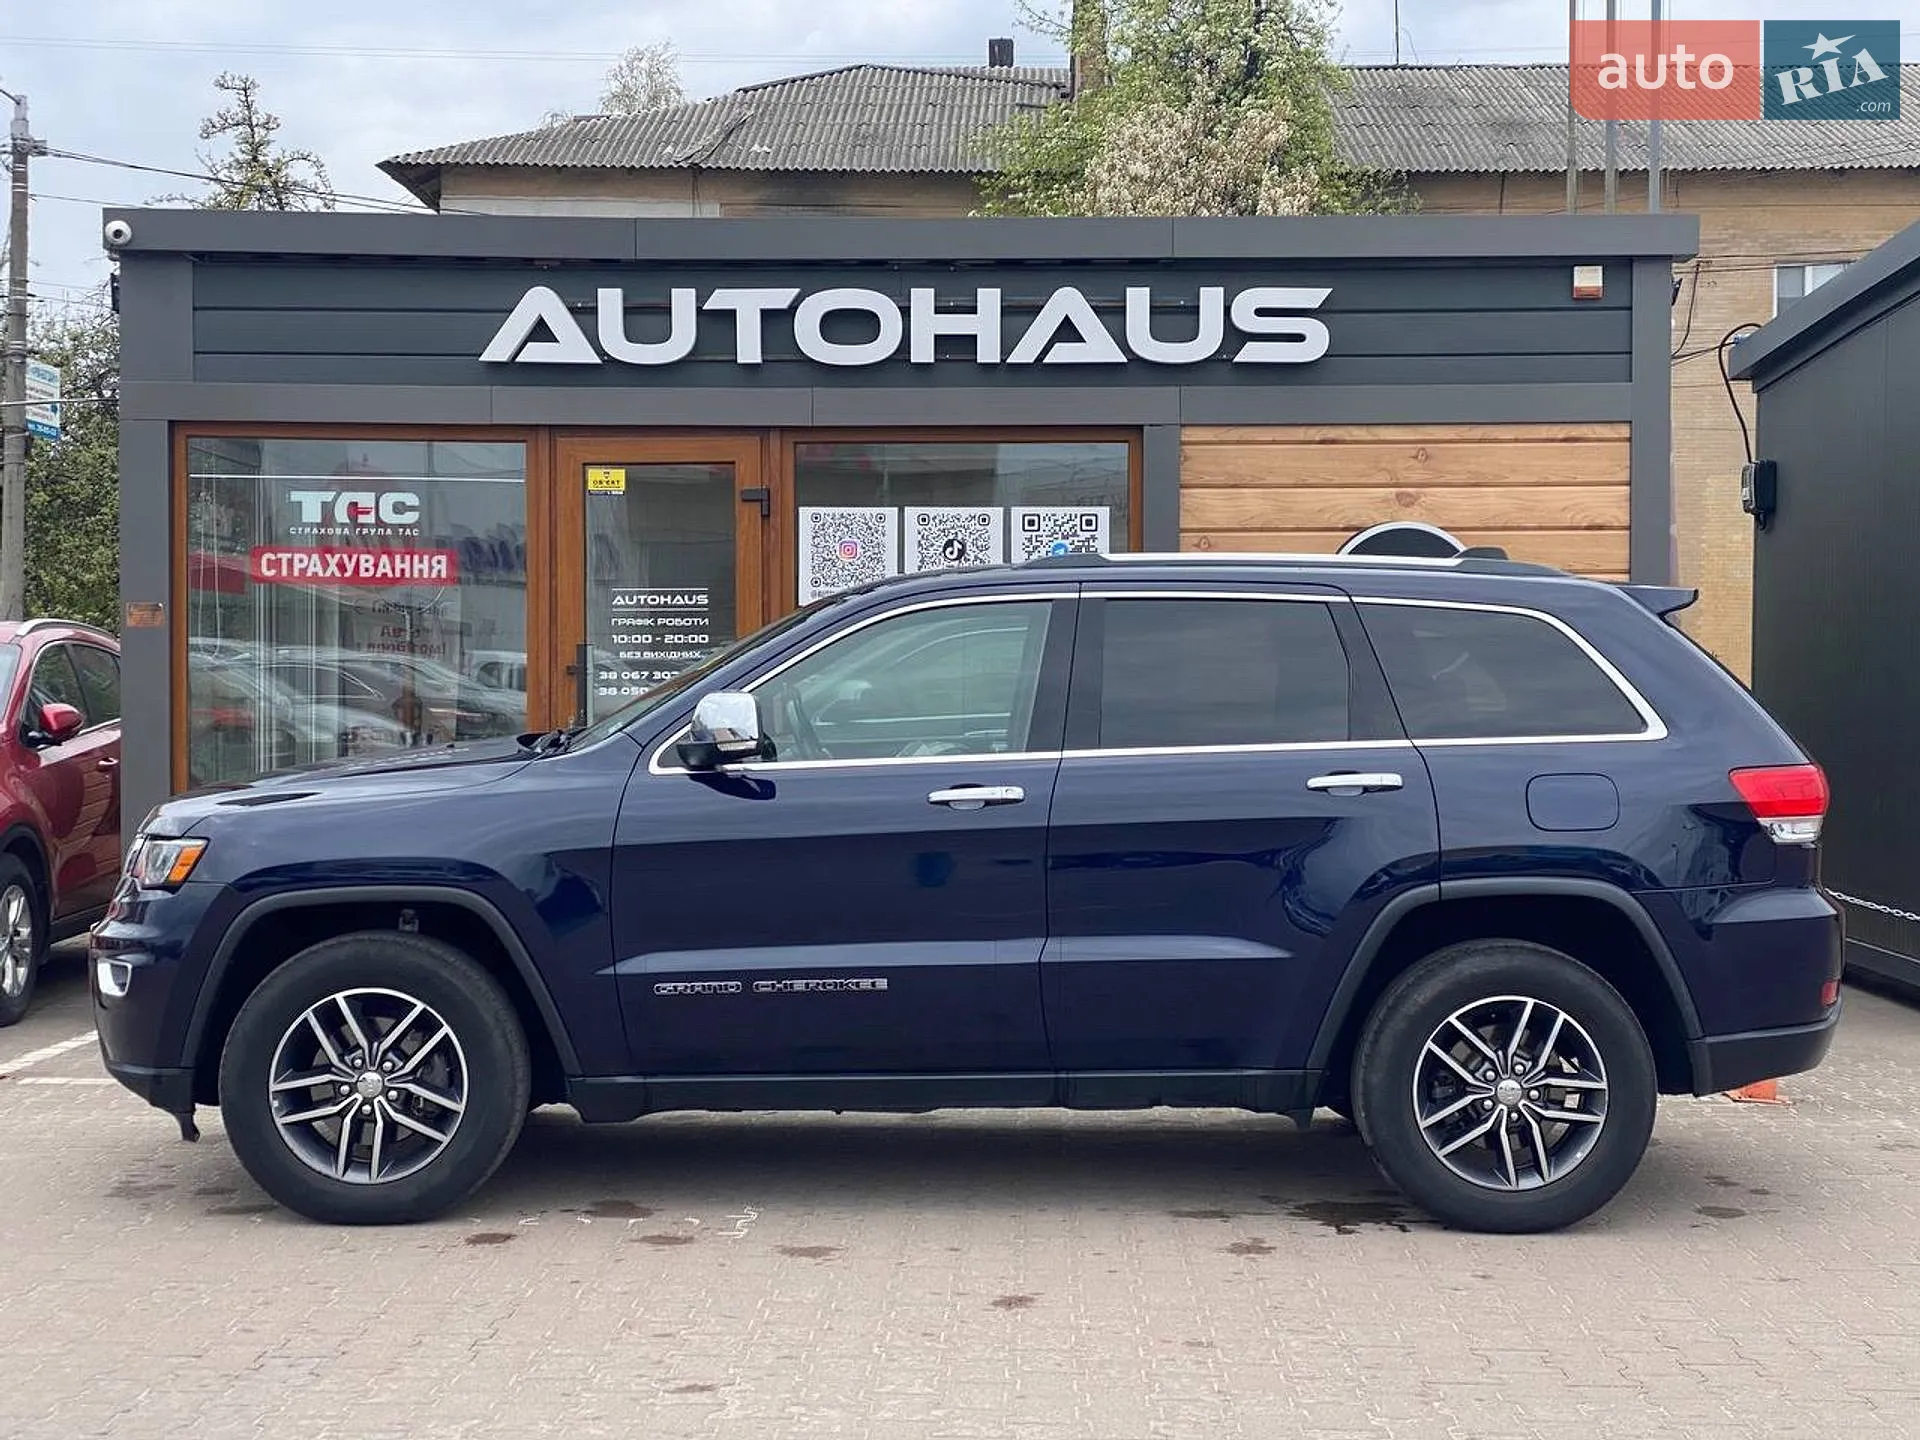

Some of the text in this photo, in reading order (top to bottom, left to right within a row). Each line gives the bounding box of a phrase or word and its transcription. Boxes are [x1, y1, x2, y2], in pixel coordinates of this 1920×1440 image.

[478, 285, 1334, 367] AUTOHAUS
[289, 527, 350, 535] СТРАХОВА
[355, 527, 393, 535] ГРУПА
[260, 552, 448, 579] СТРАХУВАННЯ
[611, 594, 709, 605] AUTOHAUS
[611, 618, 709, 626] ГРАФІК РОБОТИ
[612, 634, 652, 644] 10:00
[664, 634, 709, 644] 20:00
[619, 651, 641, 659] БЕЗ
[620, 671, 650, 680] 067
[654, 978, 888, 995] GRAND CHEROKEE
